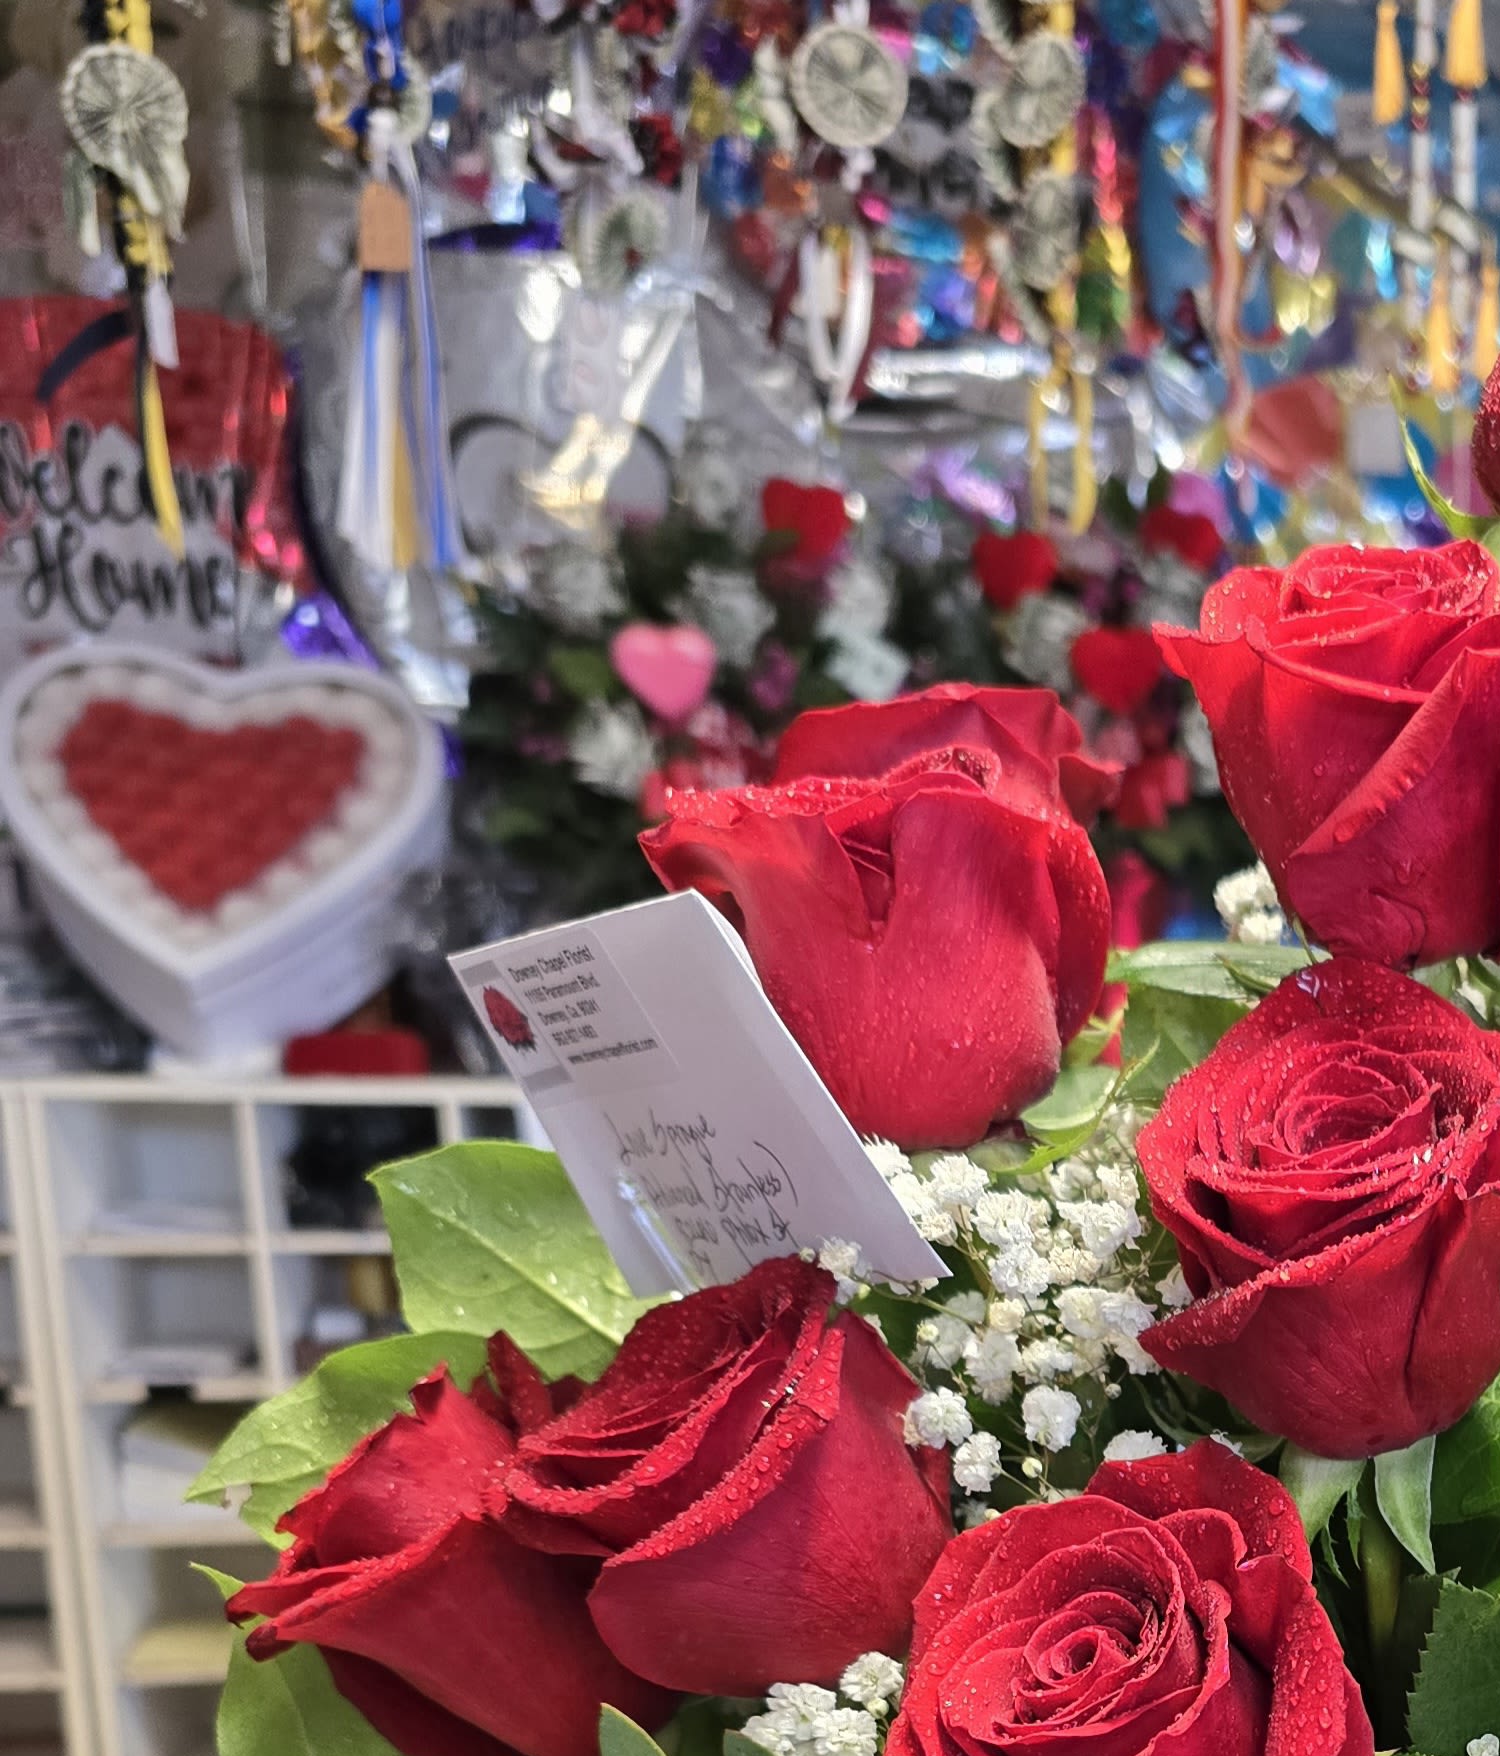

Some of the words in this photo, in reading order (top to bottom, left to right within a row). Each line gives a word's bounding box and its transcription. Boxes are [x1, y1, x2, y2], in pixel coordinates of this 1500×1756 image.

[508, 964, 544, 983] Downey
[537, 952, 569, 975] Chapel
[562, 944, 595, 967] Florist
